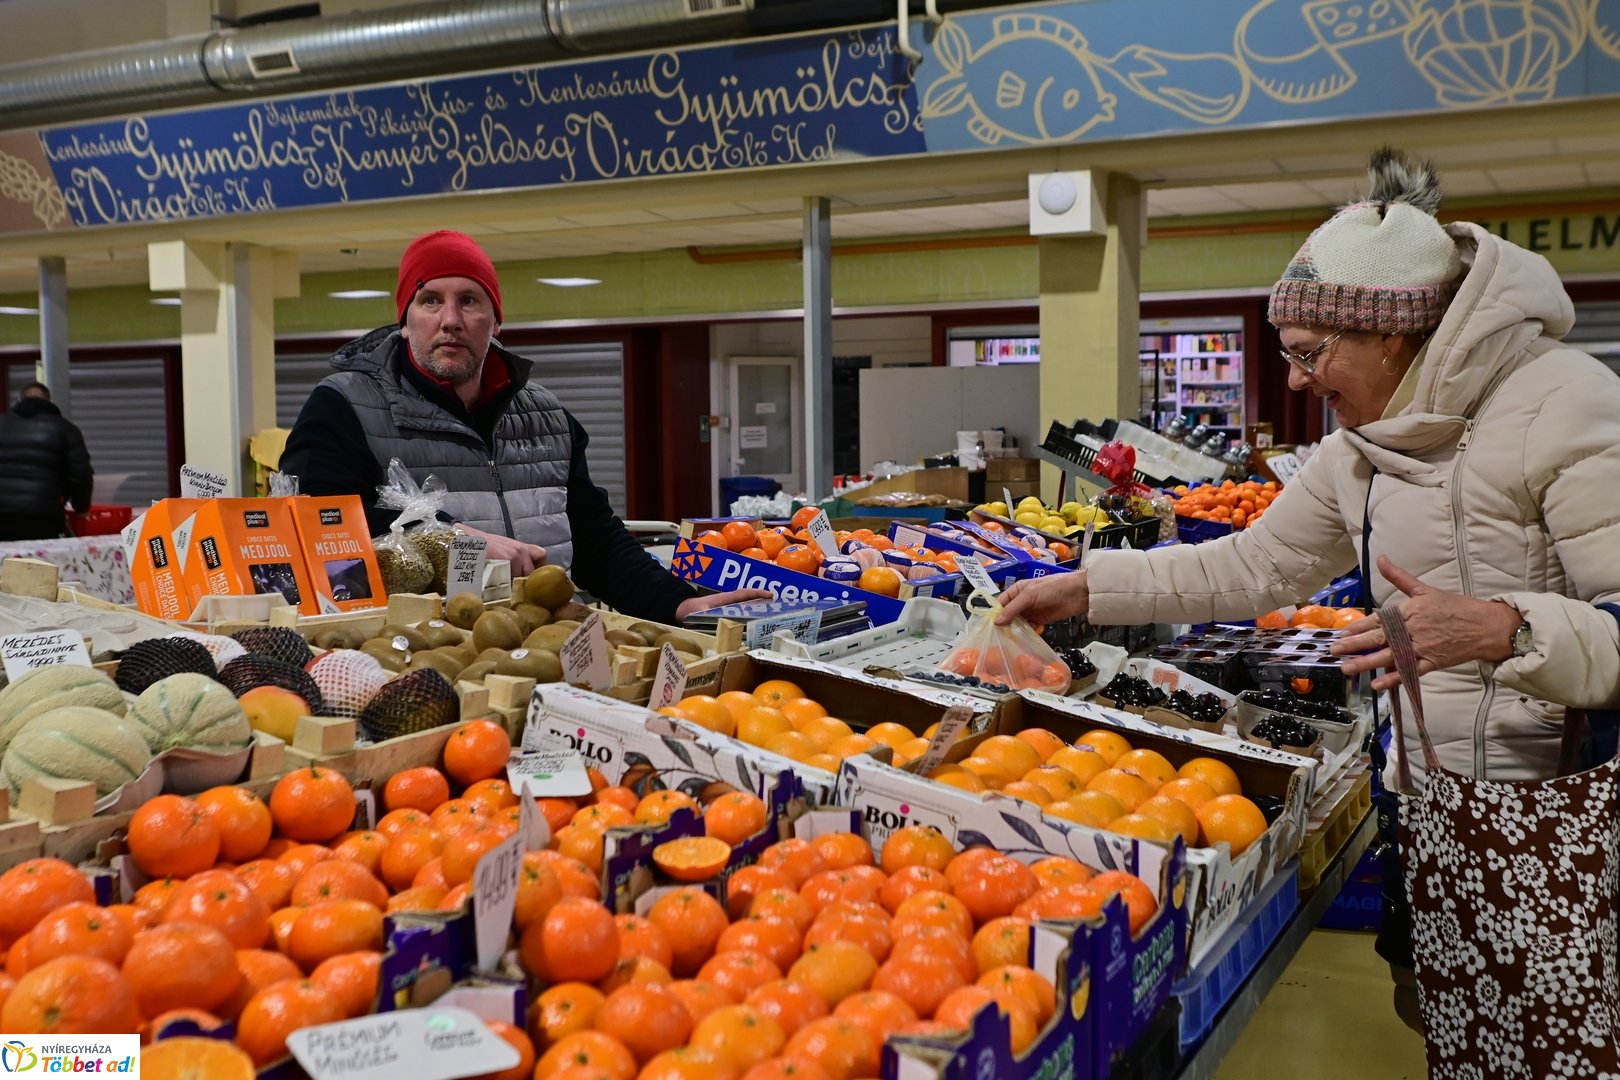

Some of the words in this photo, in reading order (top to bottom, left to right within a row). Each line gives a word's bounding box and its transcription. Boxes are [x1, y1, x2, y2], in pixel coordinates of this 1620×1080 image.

[647, 39, 894, 150] Gyümölcs
[125, 108, 307, 198] Gyümölcs
[311, 121, 438, 187] Kenyér
[429, 112, 577, 191] Zöldség
[564, 110, 718, 178] Virág
[240, 543, 292, 560] MEDJOOL
[315, 539, 364, 556] MEDJOOL
[162, 571, 181, 619] MEDJOOL
[217, 571, 231, 595] MED
